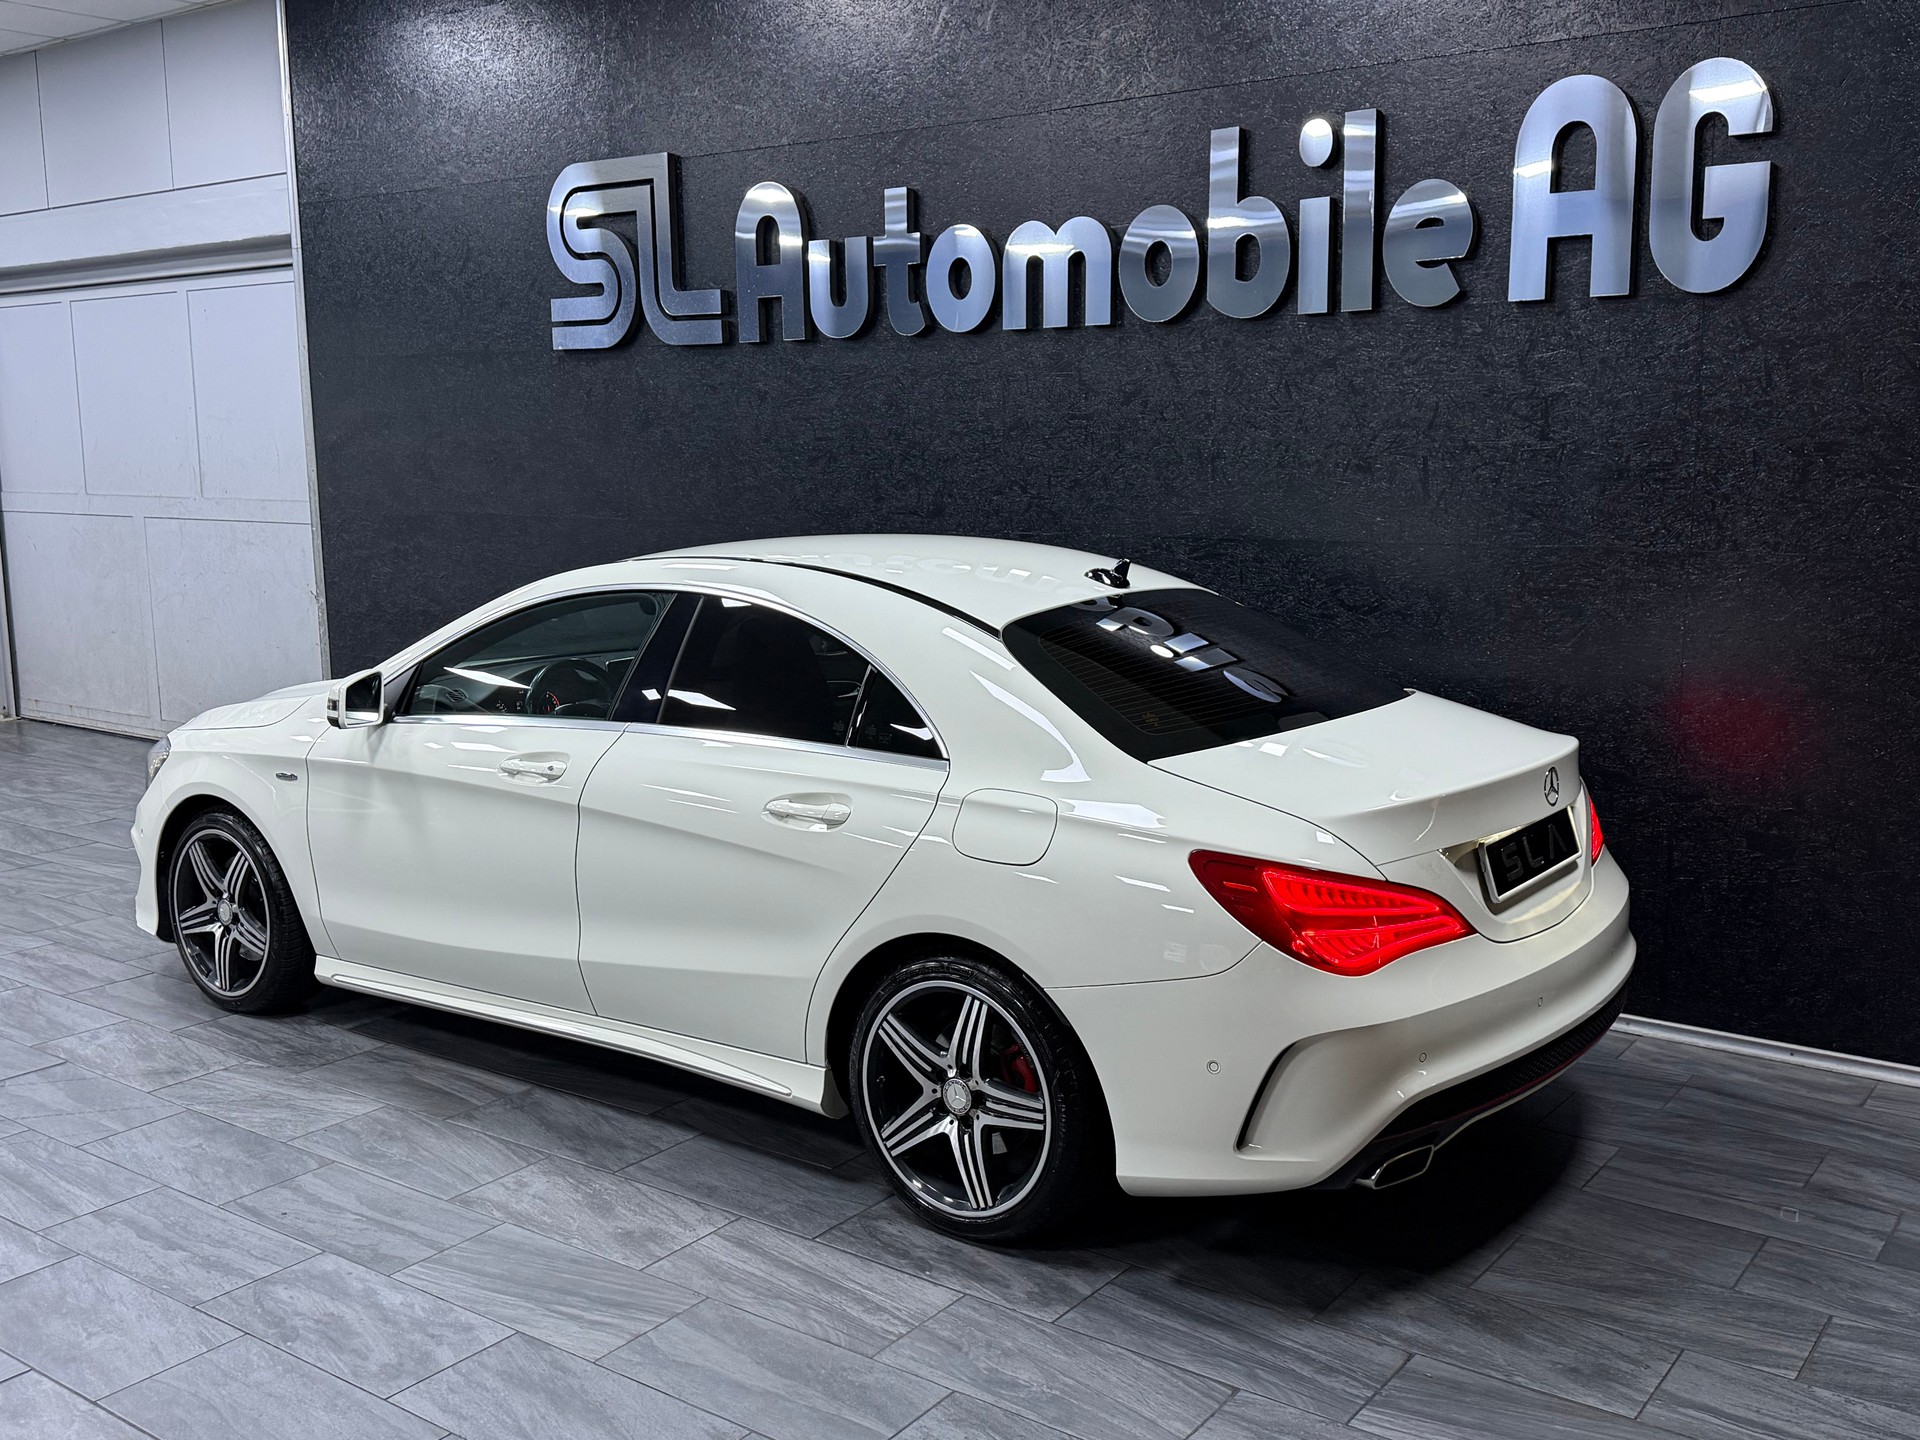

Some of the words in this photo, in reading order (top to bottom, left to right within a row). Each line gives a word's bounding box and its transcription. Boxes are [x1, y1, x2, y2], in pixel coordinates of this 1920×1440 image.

[545, 151, 725, 351] SL
[734, 108, 1476, 343] Automobile
[1508, 56, 1774, 302] AG
